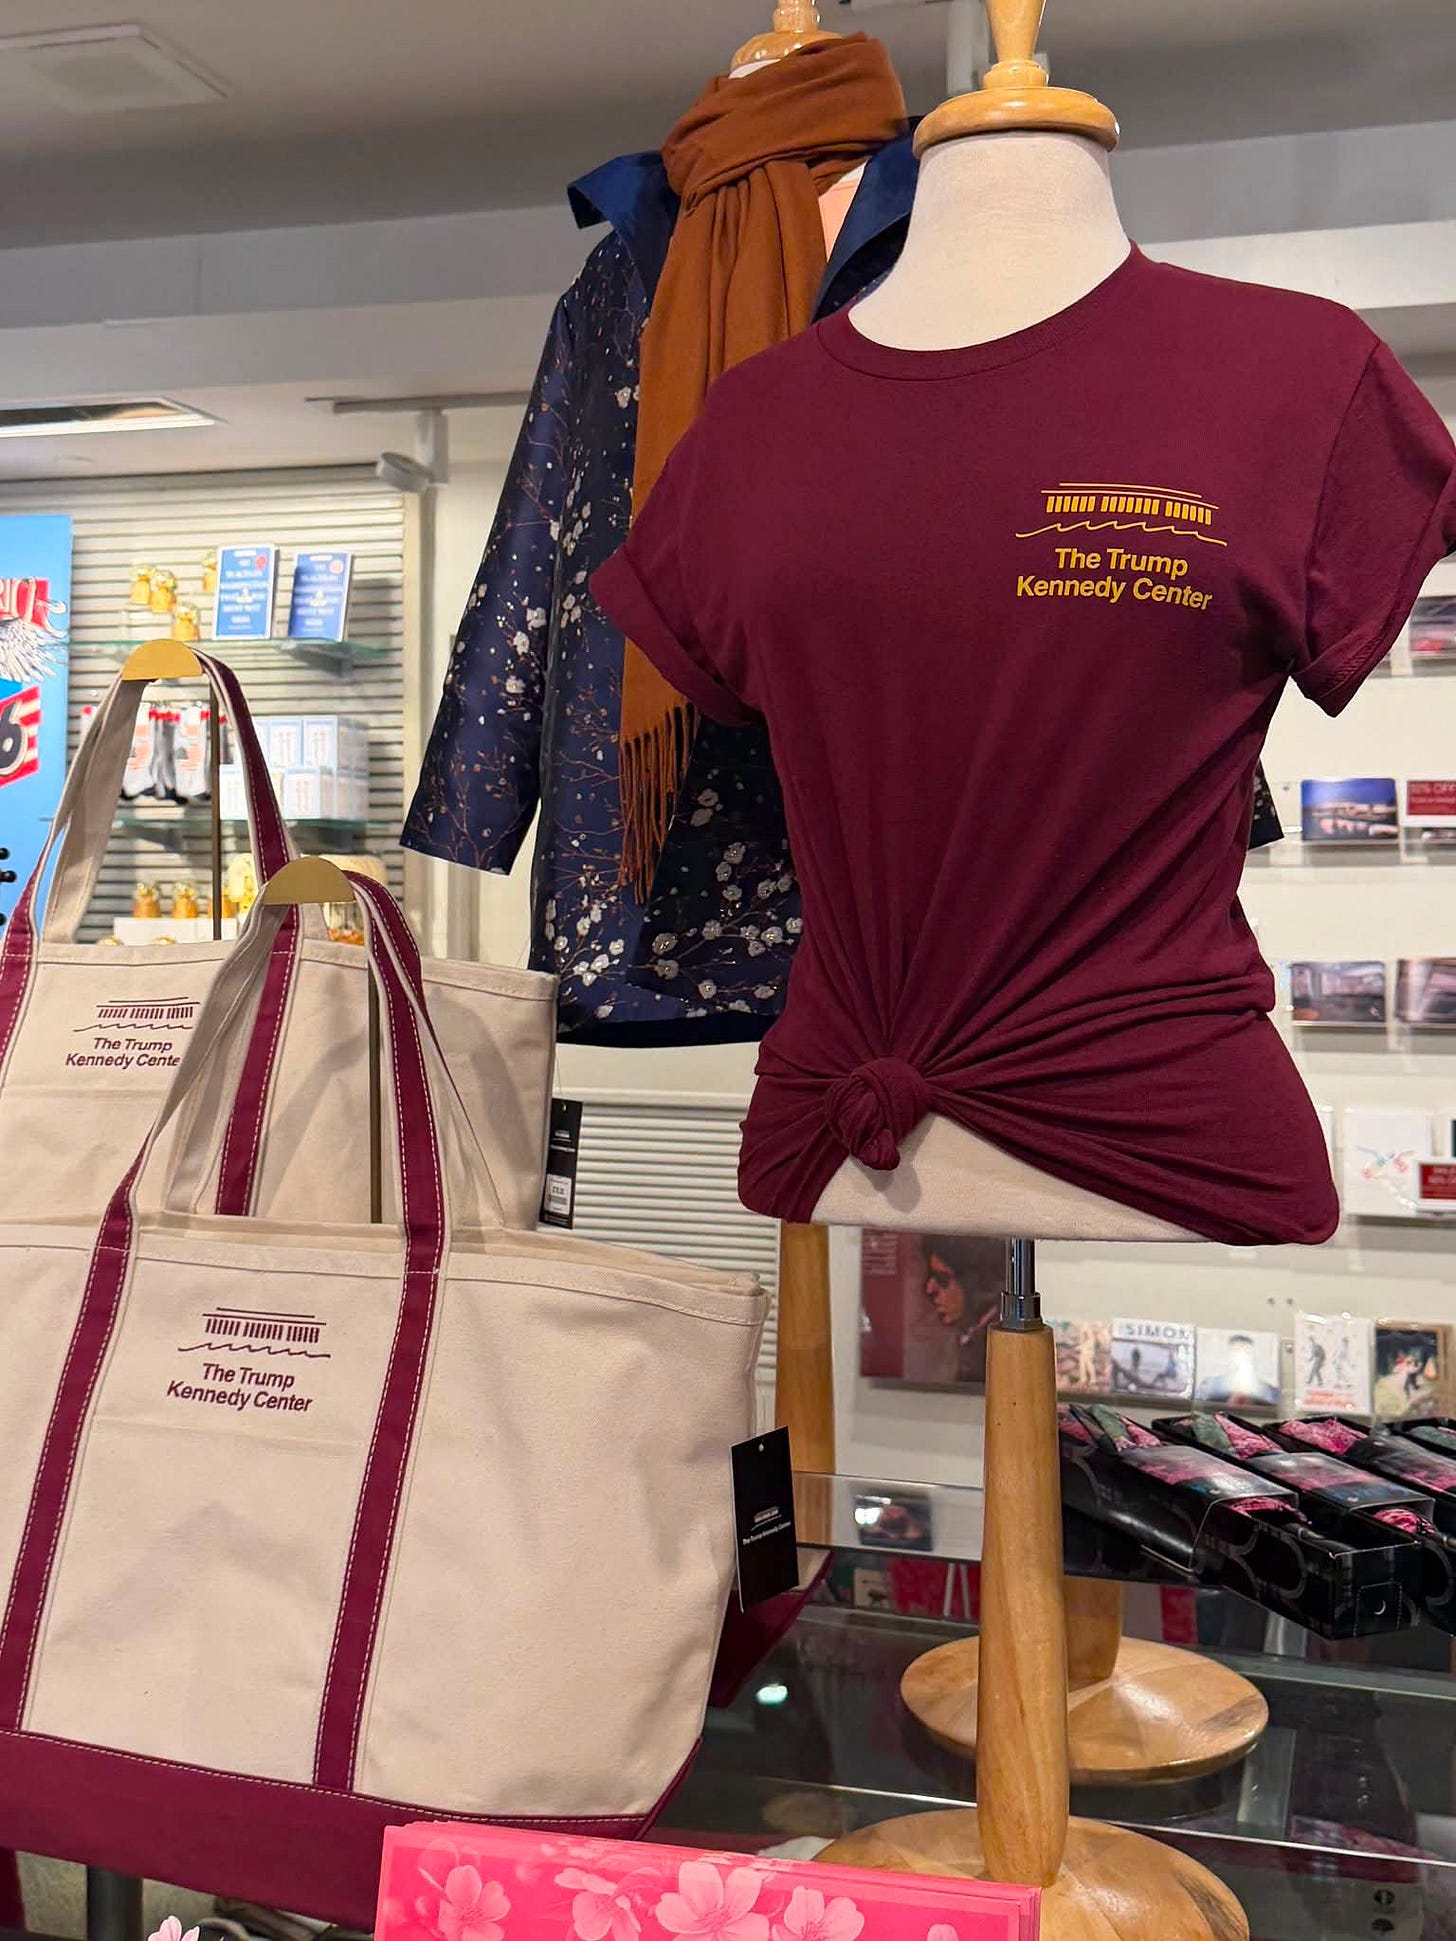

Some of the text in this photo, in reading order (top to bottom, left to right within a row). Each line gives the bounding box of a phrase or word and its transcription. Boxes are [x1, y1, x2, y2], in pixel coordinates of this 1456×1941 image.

[1054, 547, 1189, 581] The Trump
[1016, 575, 1213, 611] Kennedy Center
[93, 1037, 173, 1053] The Trump
[65, 1053, 181, 1070] Kennedy Cente
[202, 1362, 296, 1393] The Trump
[166, 1380, 314, 1412] Kennedy Center
